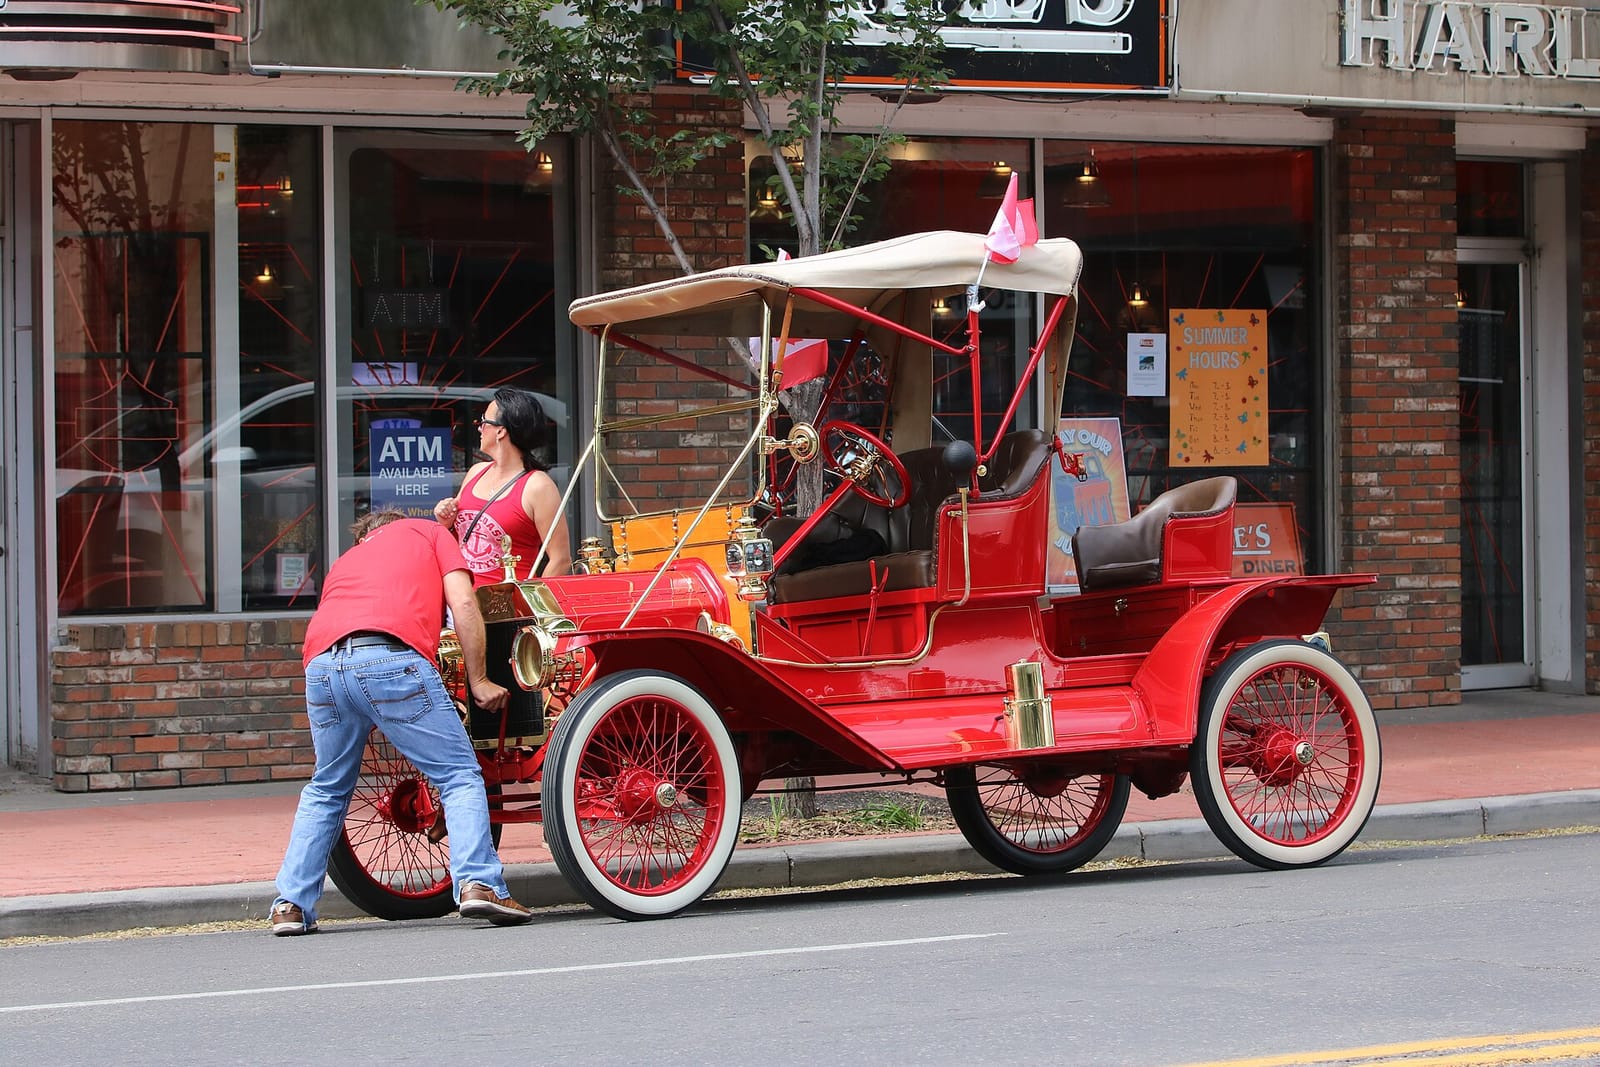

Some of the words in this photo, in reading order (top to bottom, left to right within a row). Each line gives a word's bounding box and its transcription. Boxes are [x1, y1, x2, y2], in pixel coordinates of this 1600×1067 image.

[370, 293, 441, 323] ATM
[1183, 326, 1248, 345] SUMMER
[1189, 351, 1240, 369] HOURS
[379, 436, 442, 462] ATM
[1078, 429, 1112, 456] OUR
[378, 467, 445, 479] AVAILABLE
[395, 484, 429, 496] HERE
[407, 507, 434, 517] Wher
[1233, 523, 1271, 548] E'S
[1242, 559, 1296, 574] DINER
